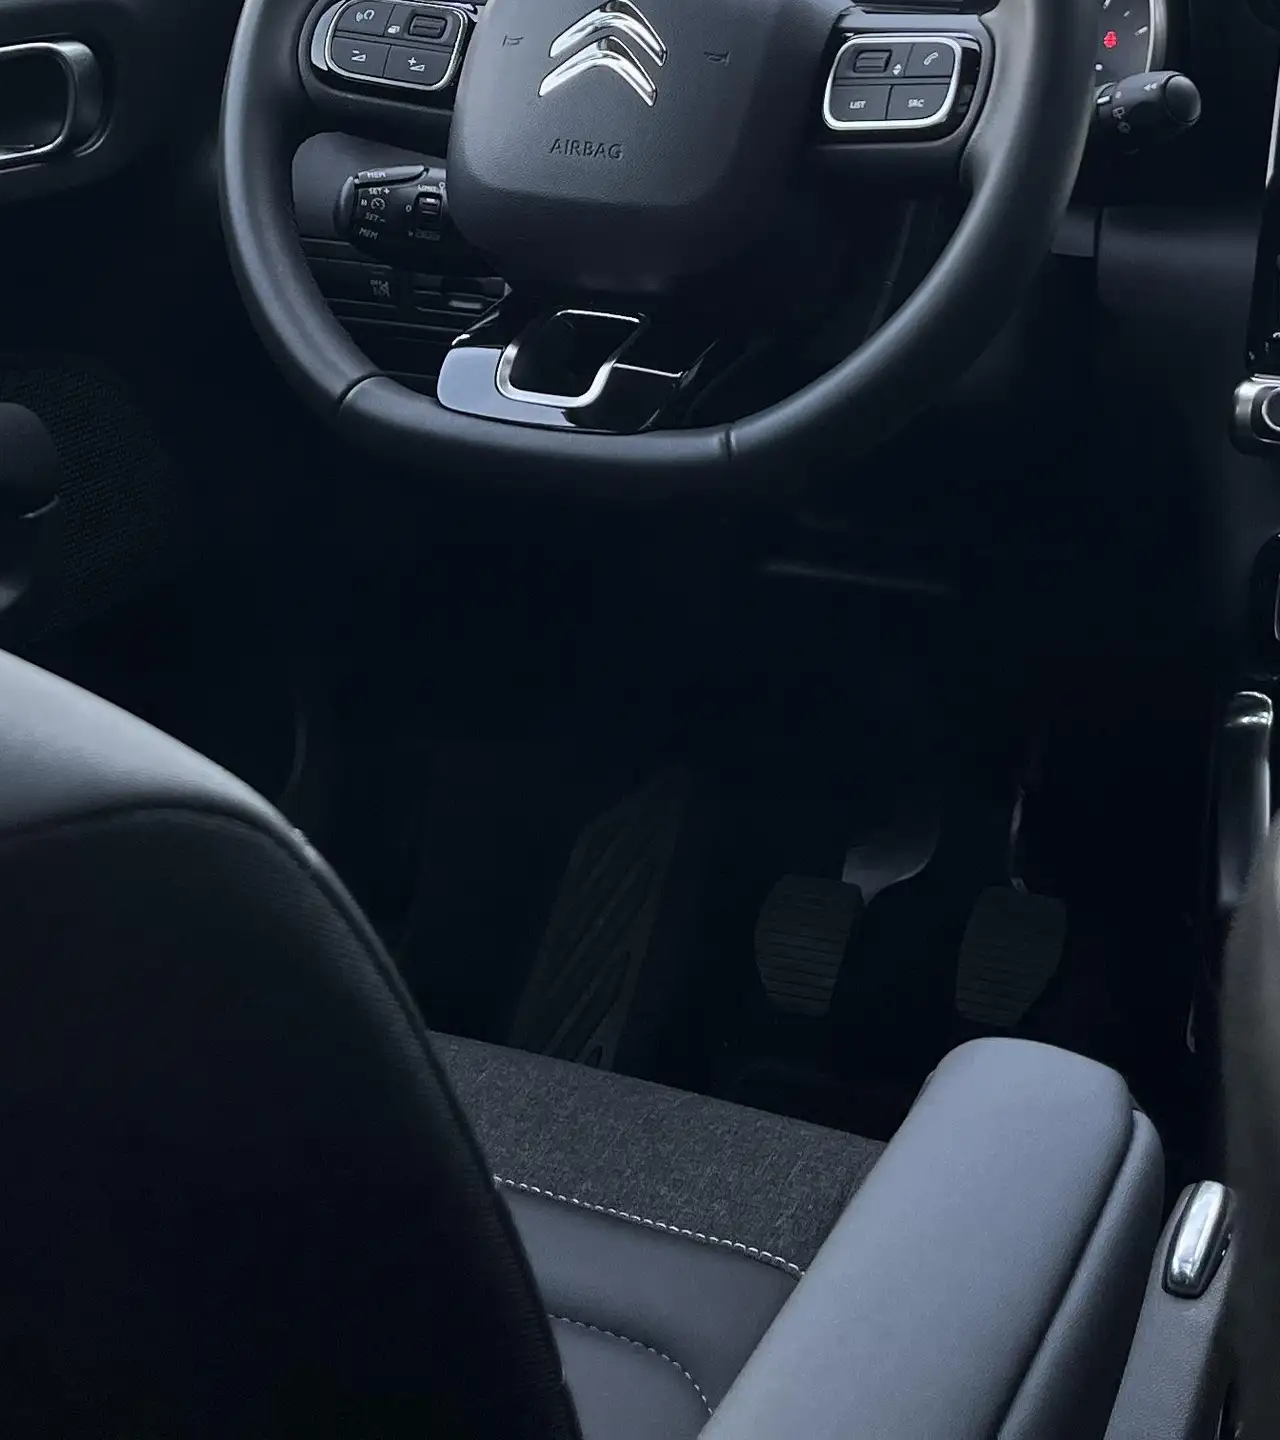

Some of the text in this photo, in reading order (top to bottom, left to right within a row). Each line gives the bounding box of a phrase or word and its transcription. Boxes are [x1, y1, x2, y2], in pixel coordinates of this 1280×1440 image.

[850, 100, 866, 109] LIST
[907, 99, 924, 108] SRC
[549, 137, 623, 159] AIRBAG
